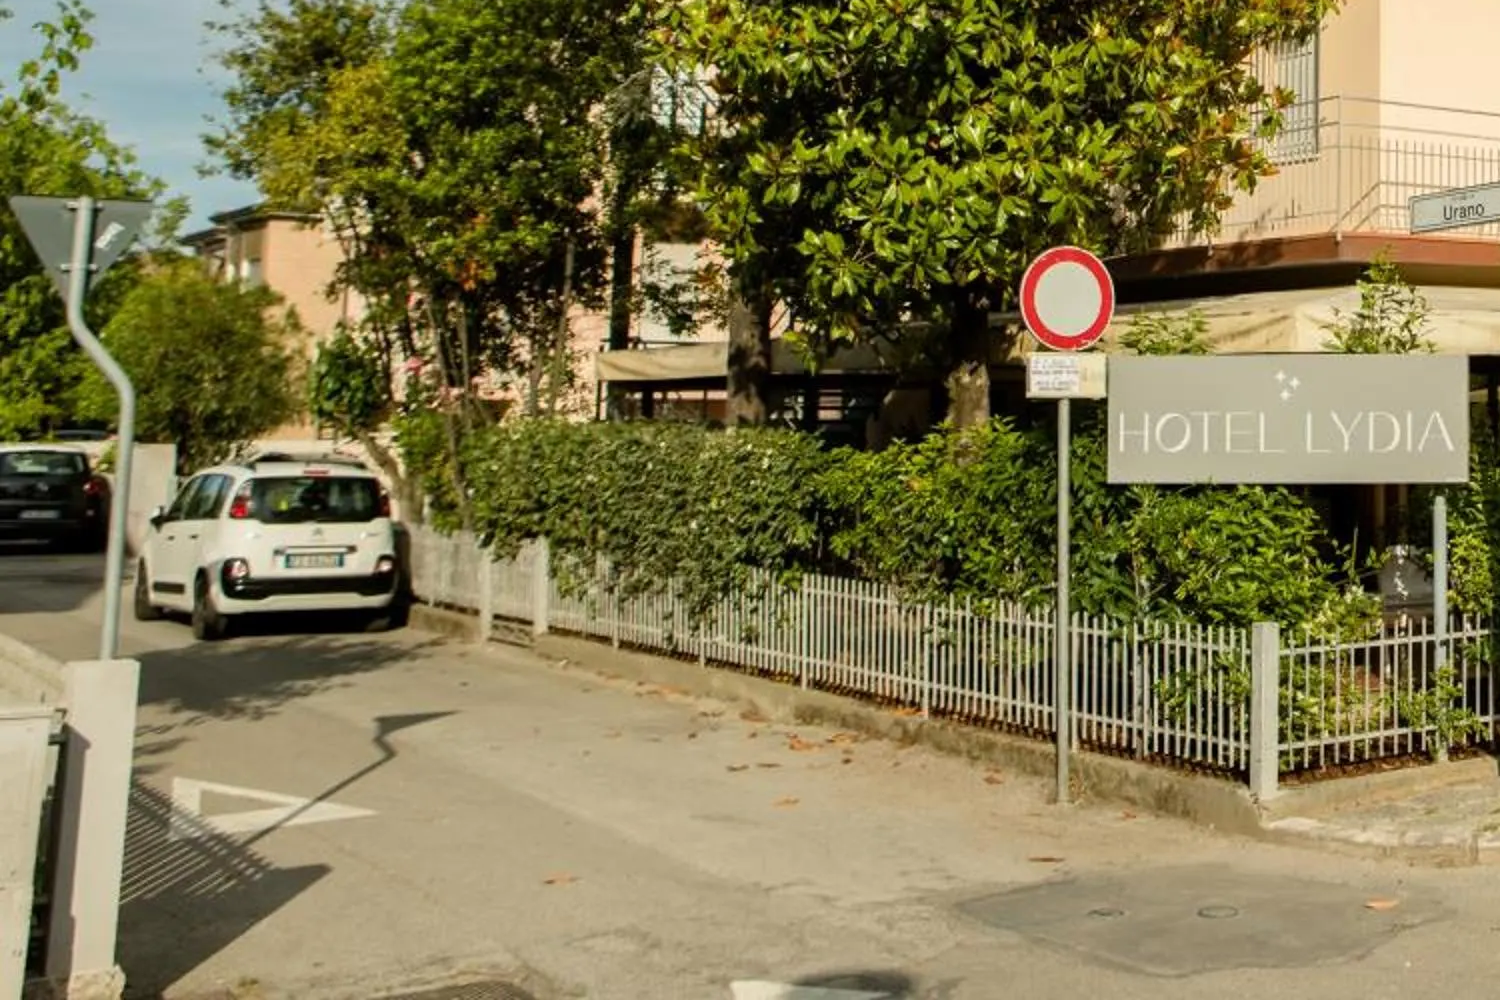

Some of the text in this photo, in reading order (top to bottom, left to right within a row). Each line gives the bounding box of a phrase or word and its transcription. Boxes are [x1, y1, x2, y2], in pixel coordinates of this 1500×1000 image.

[1443, 203, 1485, 221] Urano
[1118, 410, 1455, 454] HOTEL LYDIA
